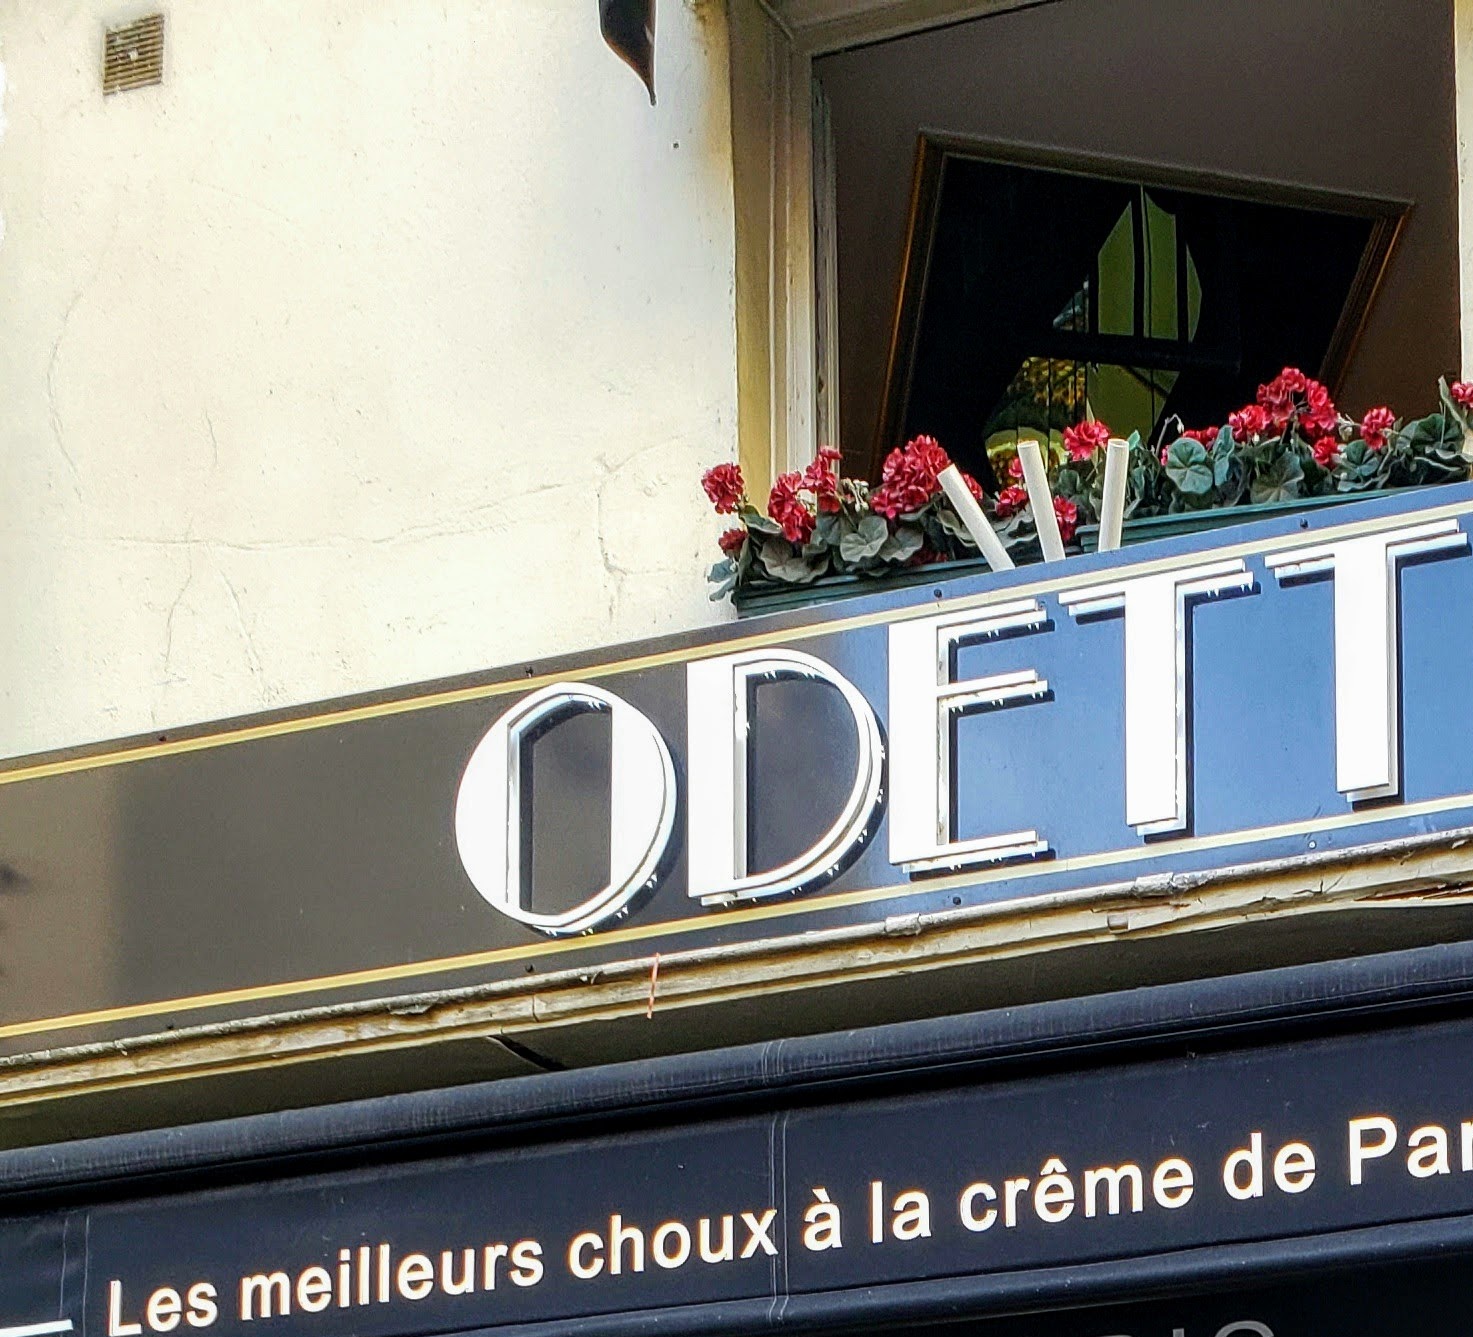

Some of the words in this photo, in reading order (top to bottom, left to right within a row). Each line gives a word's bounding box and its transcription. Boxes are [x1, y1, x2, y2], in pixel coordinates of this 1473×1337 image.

[109, 1280, 217, 1337] Les
[242, 1241, 543, 1320] meilleurs
[569, 1209, 778, 1278] choux
[804, 1188, 842, 1250] à
[872, 1181, 931, 1243] la
[960, 1159, 1193, 1231] crême
[1223, 1133, 1315, 1199] de
